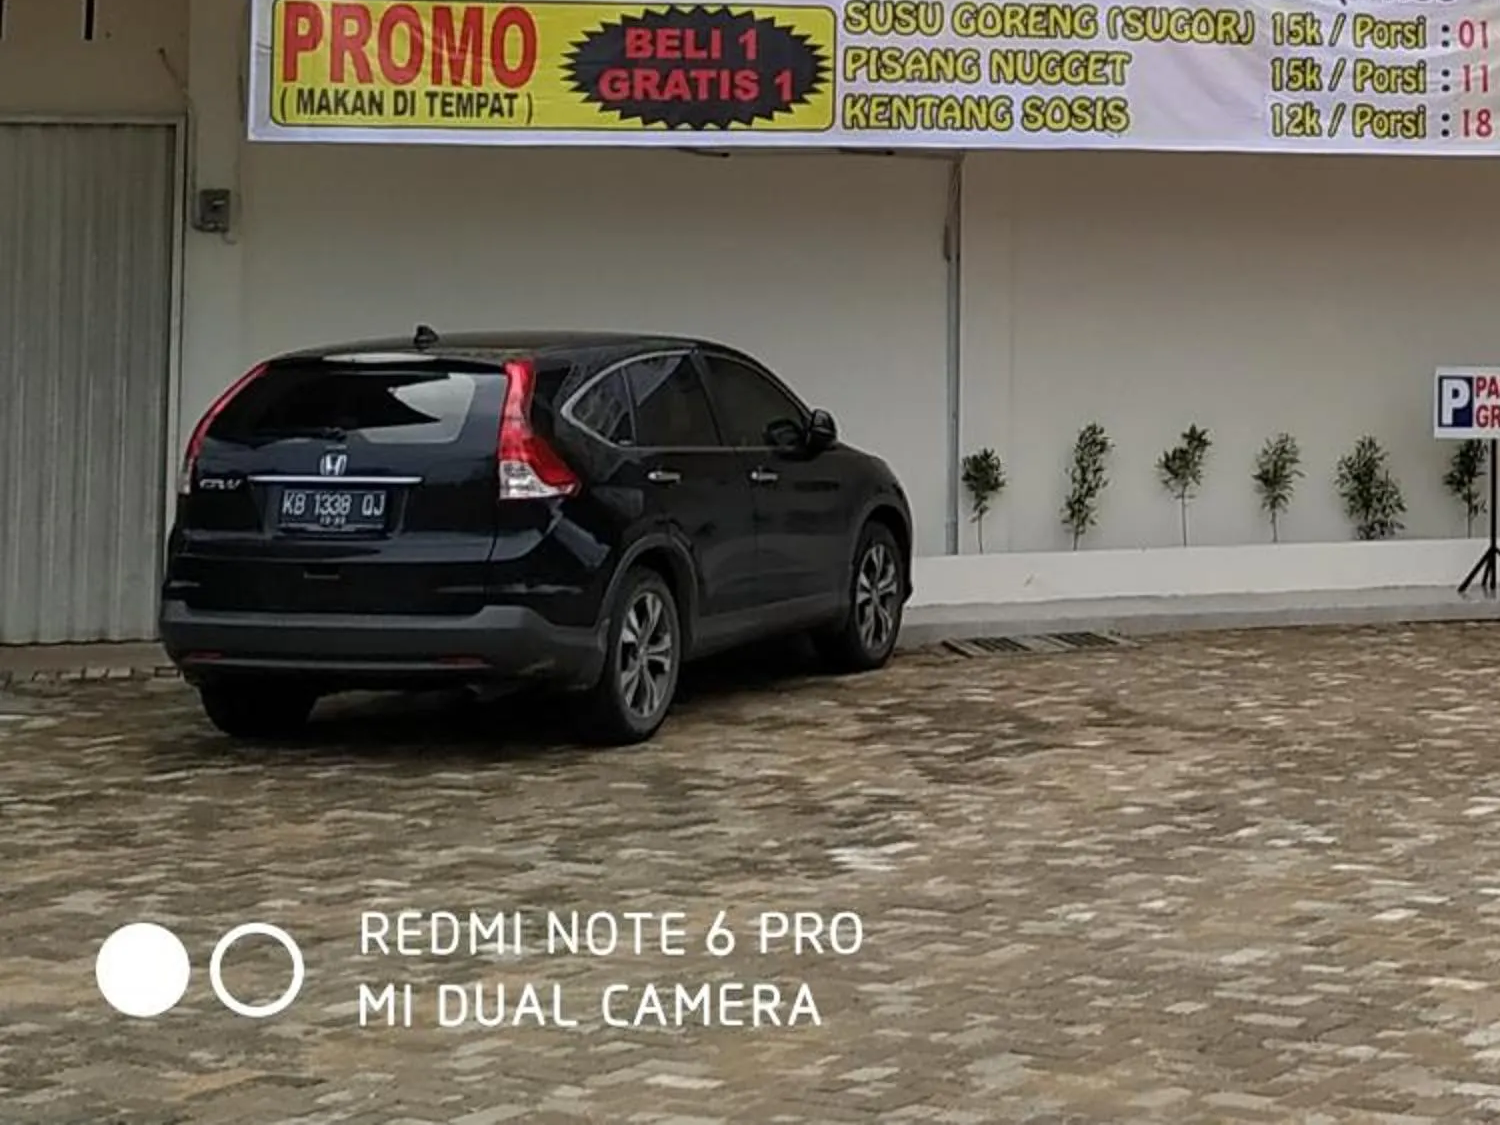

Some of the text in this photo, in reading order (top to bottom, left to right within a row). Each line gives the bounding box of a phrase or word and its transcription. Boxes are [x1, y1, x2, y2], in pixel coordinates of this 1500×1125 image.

[281, 0, 538, 89] PROMO
[625, 27, 758, 61] BELI 1
[952, 1, 1099, 40] GORENG
[1106, 4, 1256, 45] (SUGOR)
[1270, 10, 1323, 48] 15k
[1353, 13, 1427, 49] Porsi
[1459, 20, 1488, 49] 01
[599, 68, 794, 102] GRATIS 1
[844, 47, 980, 83] PISANG
[990, 50, 1132, 87] NUGGET
[1270, 56, 1322, 93] 15k
[1354, 58, 1427, 93] Porsi
[1463, 64, 1488, 93] 11
[295, 88, 384, 116] MAKAN
[393, 90, 416, 117] DI
[424, 91, 518, 119] TEMPAT
[842, 94, 1013, 132] KENTANG
[1021, 96, 1130, 133] SOSIS
[1270, 102, 1321, 139] 12k
[1352, 102, 1427, 139] Porsi
[1463, 108, 1492, 138] 18
[1442, 378, 1470, 425] P
